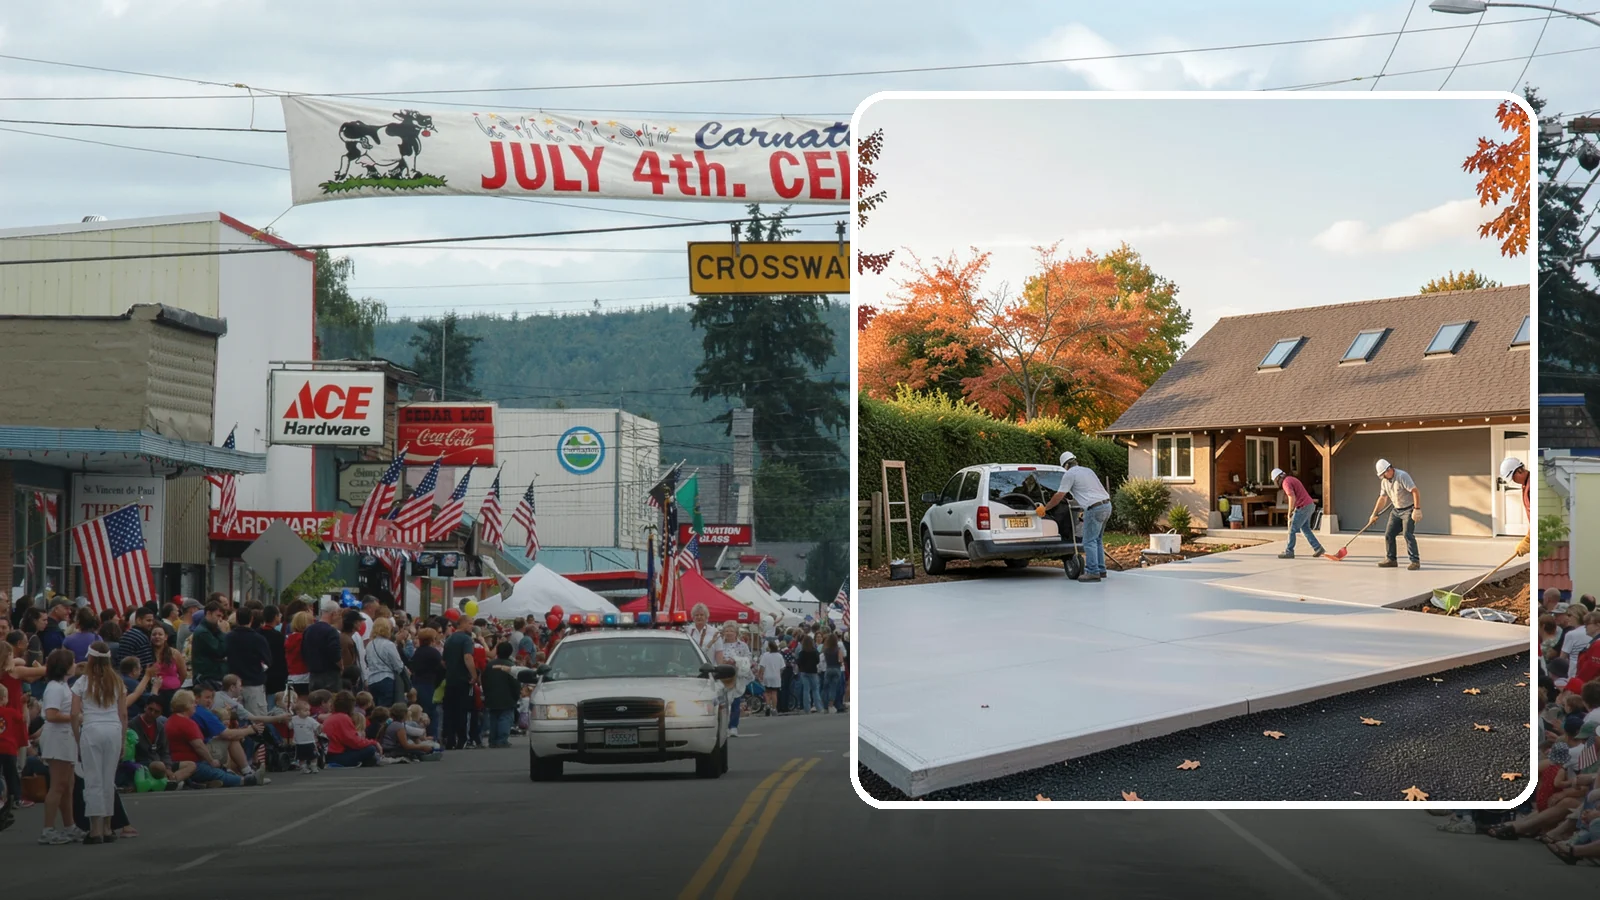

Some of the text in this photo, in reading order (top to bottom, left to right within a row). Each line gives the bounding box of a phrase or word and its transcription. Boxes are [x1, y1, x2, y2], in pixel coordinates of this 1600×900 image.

[481, 141, 605, 193] JULY
[632, 150, 746, 198] 4th.
[697, 254, 850, 280] CROSSWA
[282, 380, 373, 420] ACE
[406, 409, 485, 422] CEDAR LOG
[283, 421, 371, 436] Hardware
[416, 428, 477, 447] Coca-Cola
[353, 467, 386, 479] Simpl
[95, 485, 124, 495] Vincent
[126, 486, 136, 495] de
[137, 486, 155, 495] Paul
[213, 516, 331, 535] HARDARE
[688, 526, 741, 535] CRNATION
[699, 535, 730, 543] GLASS
